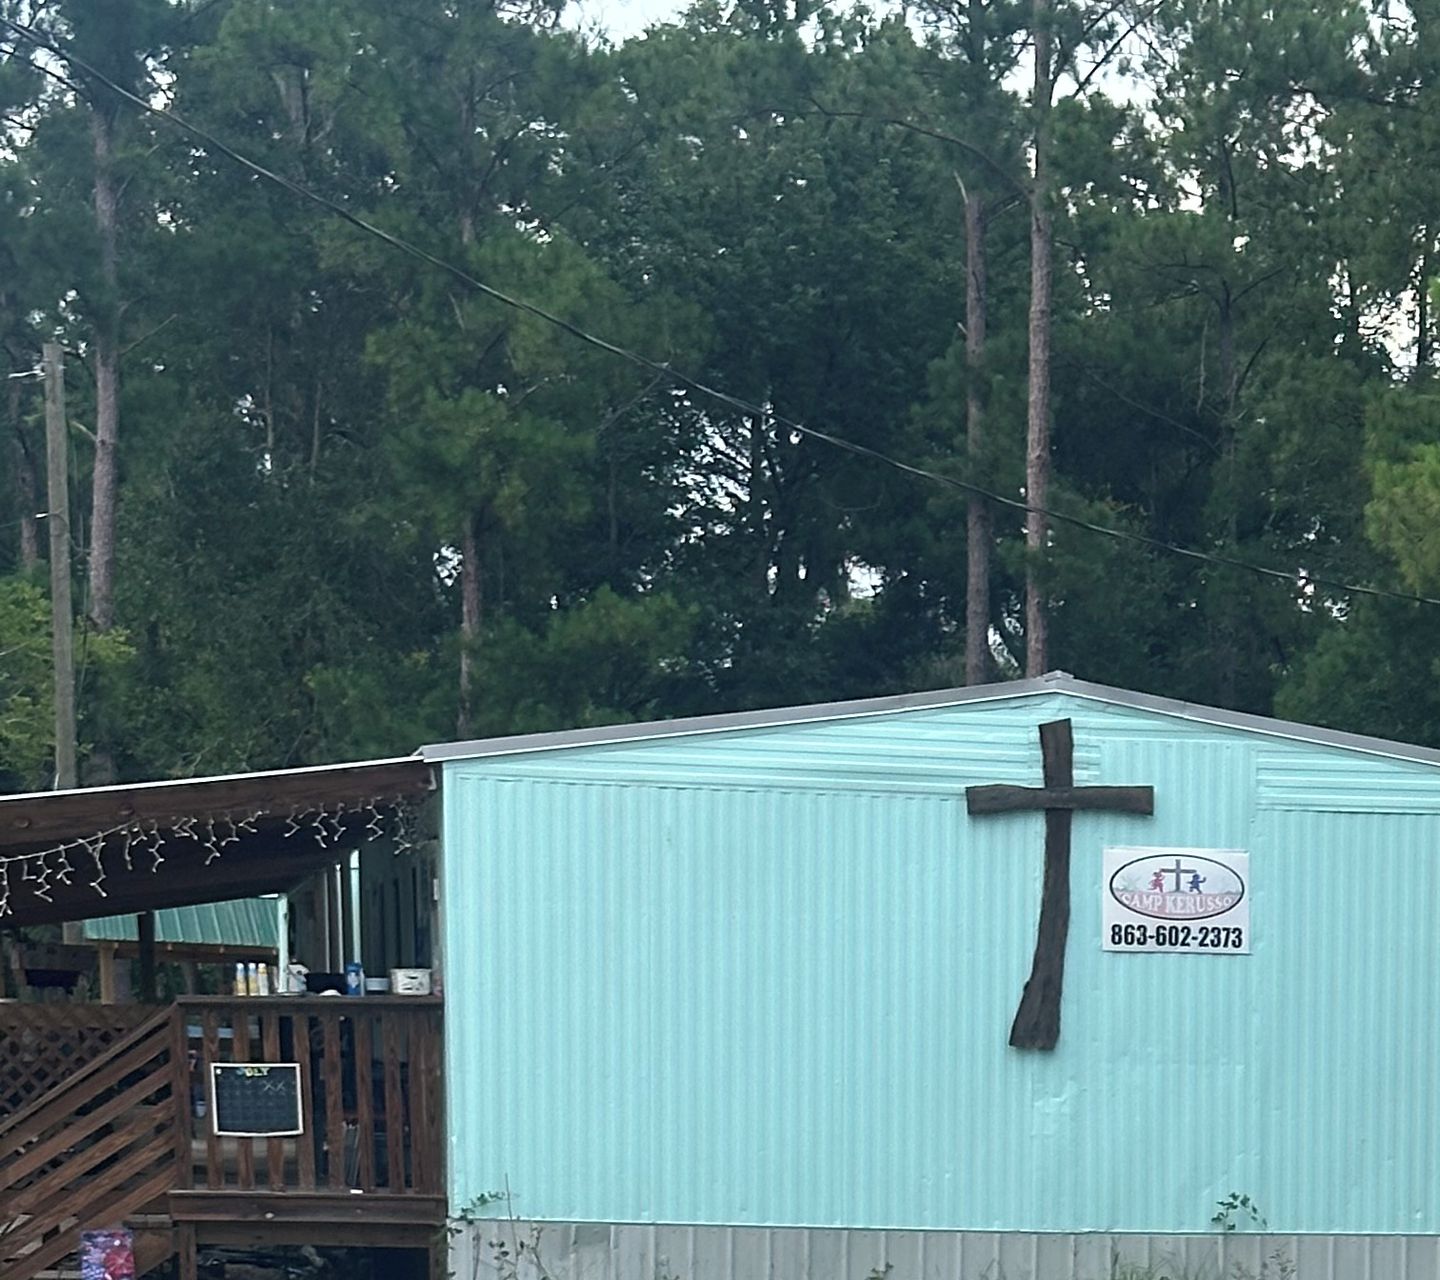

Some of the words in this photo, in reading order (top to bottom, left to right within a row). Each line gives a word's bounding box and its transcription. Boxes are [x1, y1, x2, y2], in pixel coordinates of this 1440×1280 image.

[1122, 894, 1163, 912] CAMP
[1165, 895, 1232, 914] KERUSSO
[1111, 924, 1243, 948] 863-602-2373
